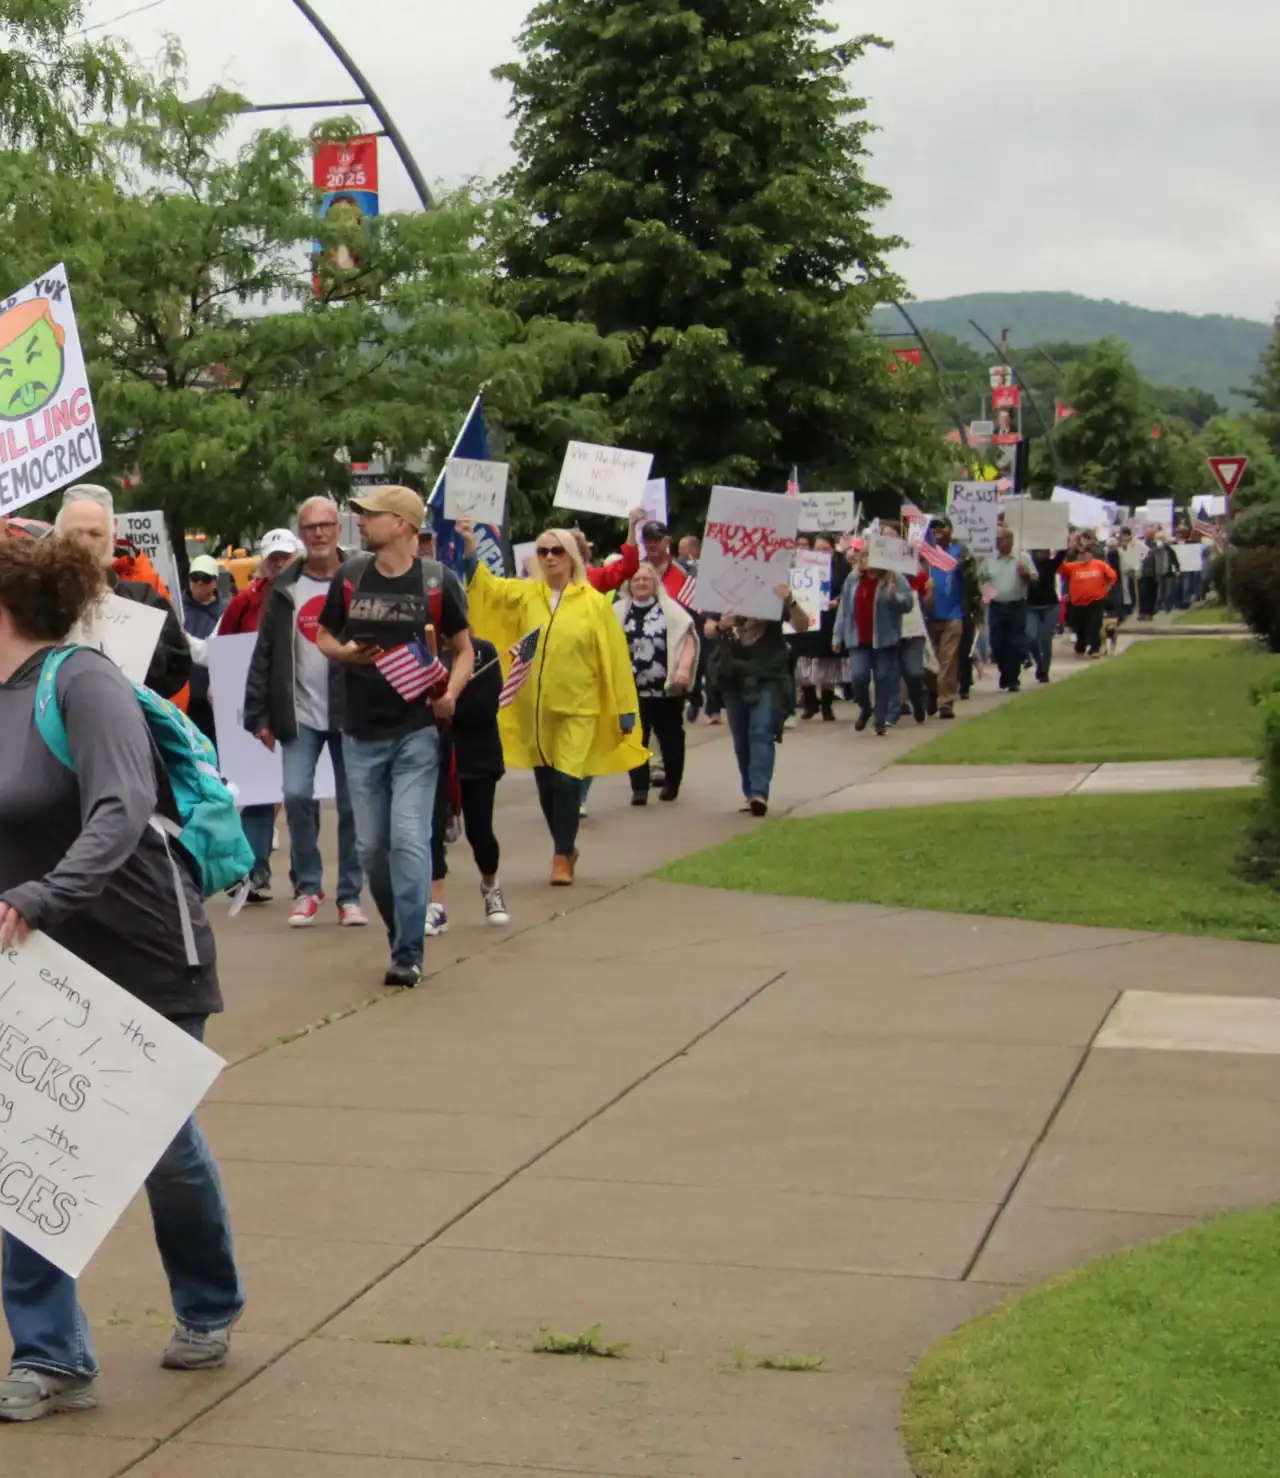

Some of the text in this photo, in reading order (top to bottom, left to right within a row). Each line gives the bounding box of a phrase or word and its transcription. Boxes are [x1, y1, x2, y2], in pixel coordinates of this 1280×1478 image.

[327, 172, 365, 187] 2025
[33, 279, 67, 302] YUK
[127, 517, 152, 531] TOO
[125, 532, 160, 545] MUCH
[39, 967, 92, 1028] eating
[119, 1018, 158, 1063] the
[45, 1123, 81, 1156] the
